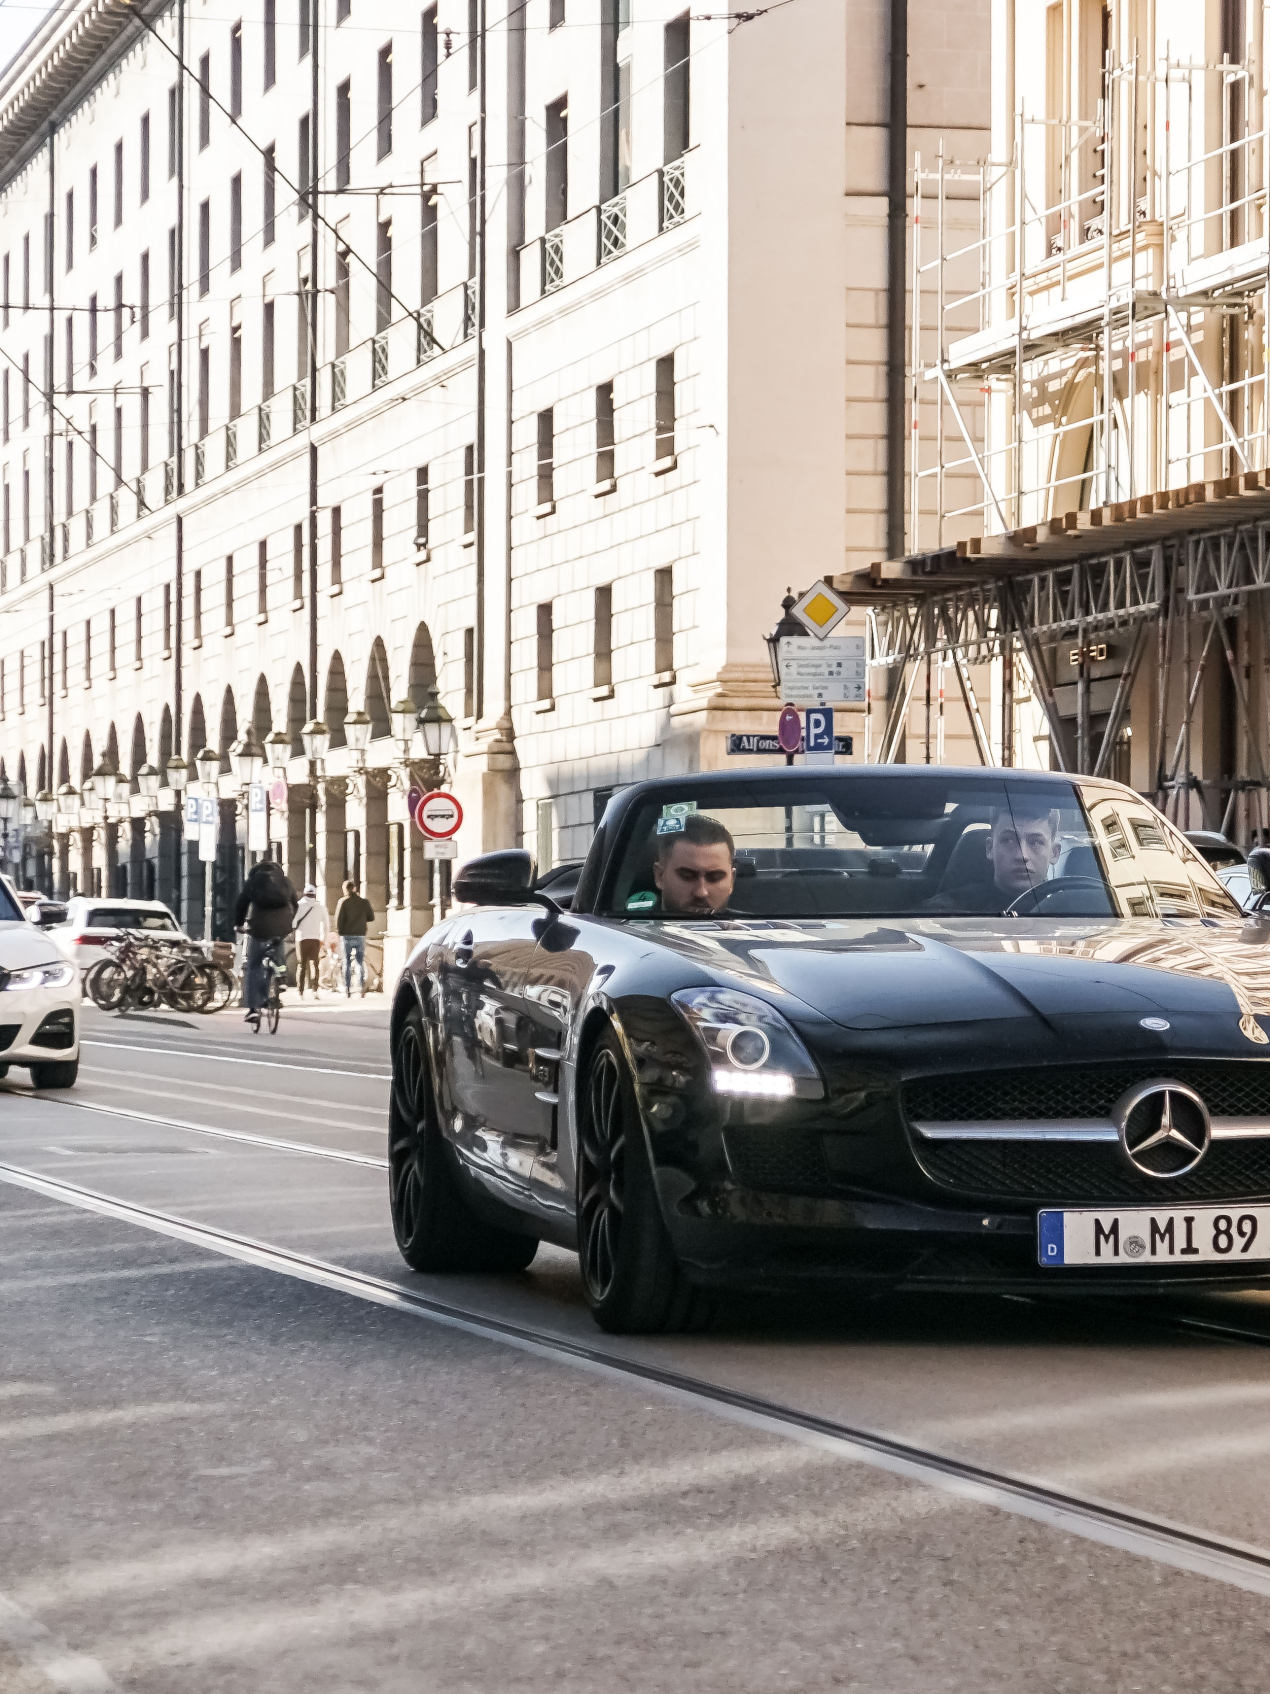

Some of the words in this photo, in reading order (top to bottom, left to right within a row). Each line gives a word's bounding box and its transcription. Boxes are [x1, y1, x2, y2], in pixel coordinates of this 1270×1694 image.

[1069, 644, 1106, 665] EO
[809, 713, 826, 747] P
[1094, 1217, 1119, 1257] M
[1150, 1215, 1200, 1256] MI
[1212, 1214, 1258, 1254] 89
[1048, 1244, 1057, 1256] D
